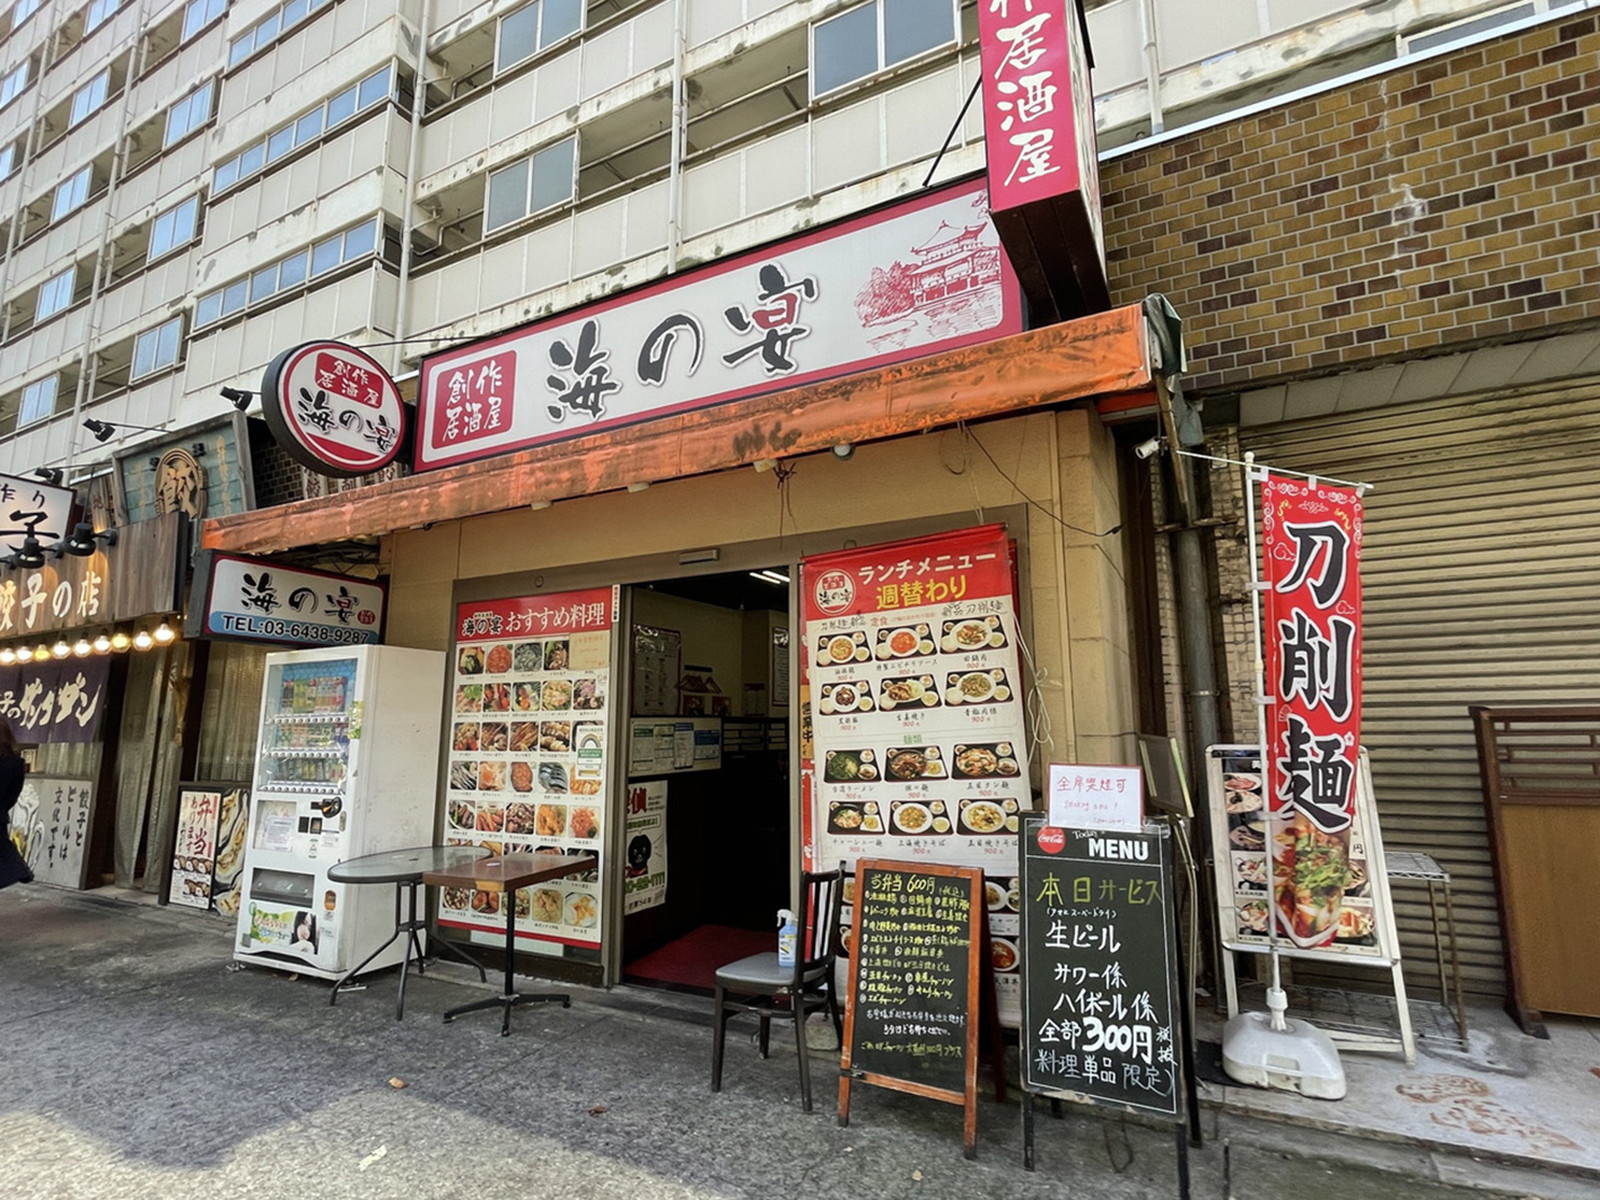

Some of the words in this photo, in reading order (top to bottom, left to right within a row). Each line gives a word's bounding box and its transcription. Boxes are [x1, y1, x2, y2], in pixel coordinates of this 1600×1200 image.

[546, 262, 819, 422] 海の宴
[316, 368, 379, 407] 居酒屋
[447, 359, 502, 406] 創作
[297, 387, 397, 452] 海の宴
[442, 397, 502, 442] 居酒屋
[858, 552, 996, 586] ランチメニュー
[241, 572, 359, 623] 海の宴
[876, 575, 967, 610] 週替わり
[222, 614, 370, 645] TEL:03-6438-9287
[461, 613, 503, 637] 海の宴
[505, 602, 606, 633] おすすめ料理
[1275, 521, 1354, 833] 刀削麺
[193, 794, 212, 855] 弁当
[1088, 837, 1149, 860] MENU
[1036, 872, 1163, 907] 本日サービス
